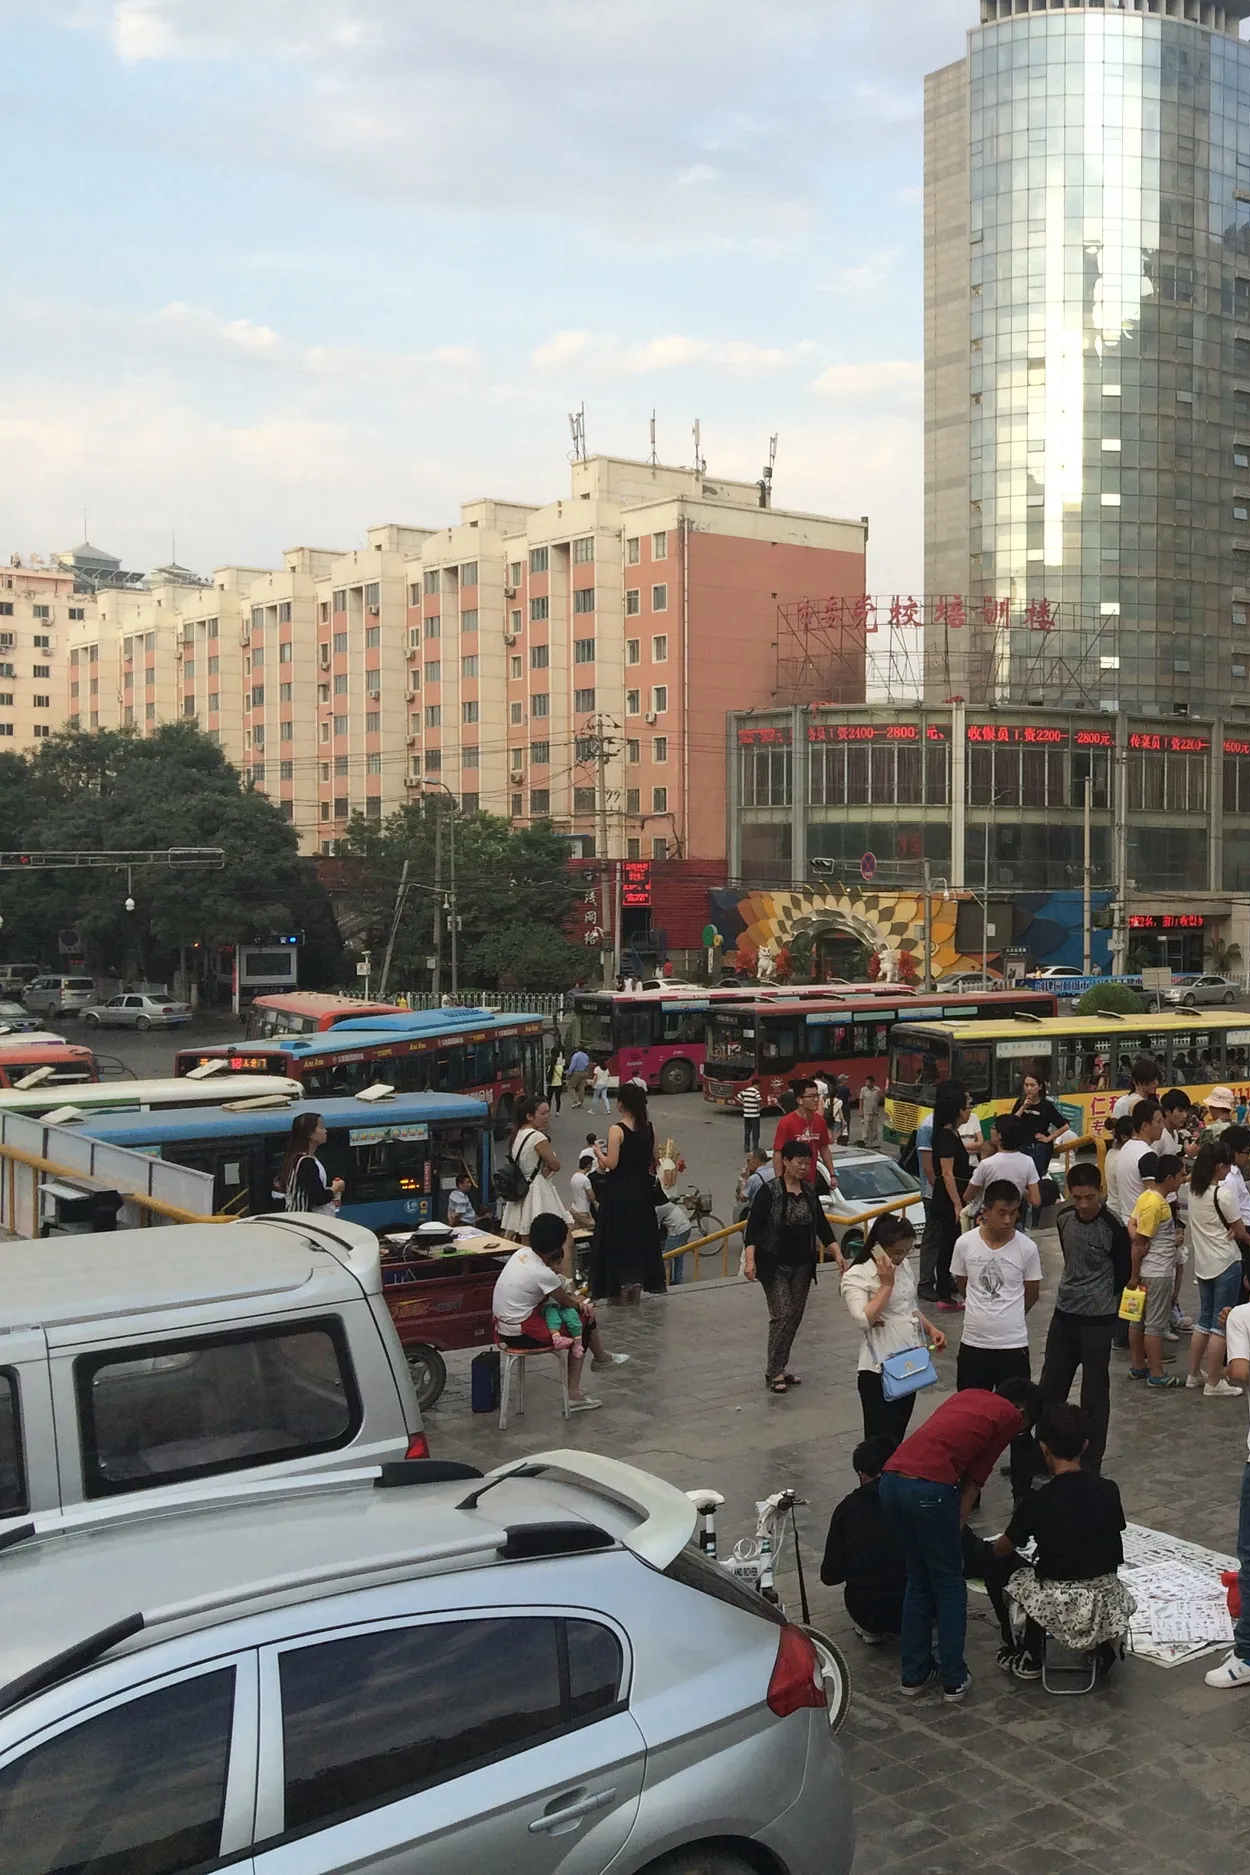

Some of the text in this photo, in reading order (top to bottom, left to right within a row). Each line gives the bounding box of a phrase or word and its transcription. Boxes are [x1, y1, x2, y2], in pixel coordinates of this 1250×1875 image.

[797, 594, 1056, 633] 市委党校培训楼
